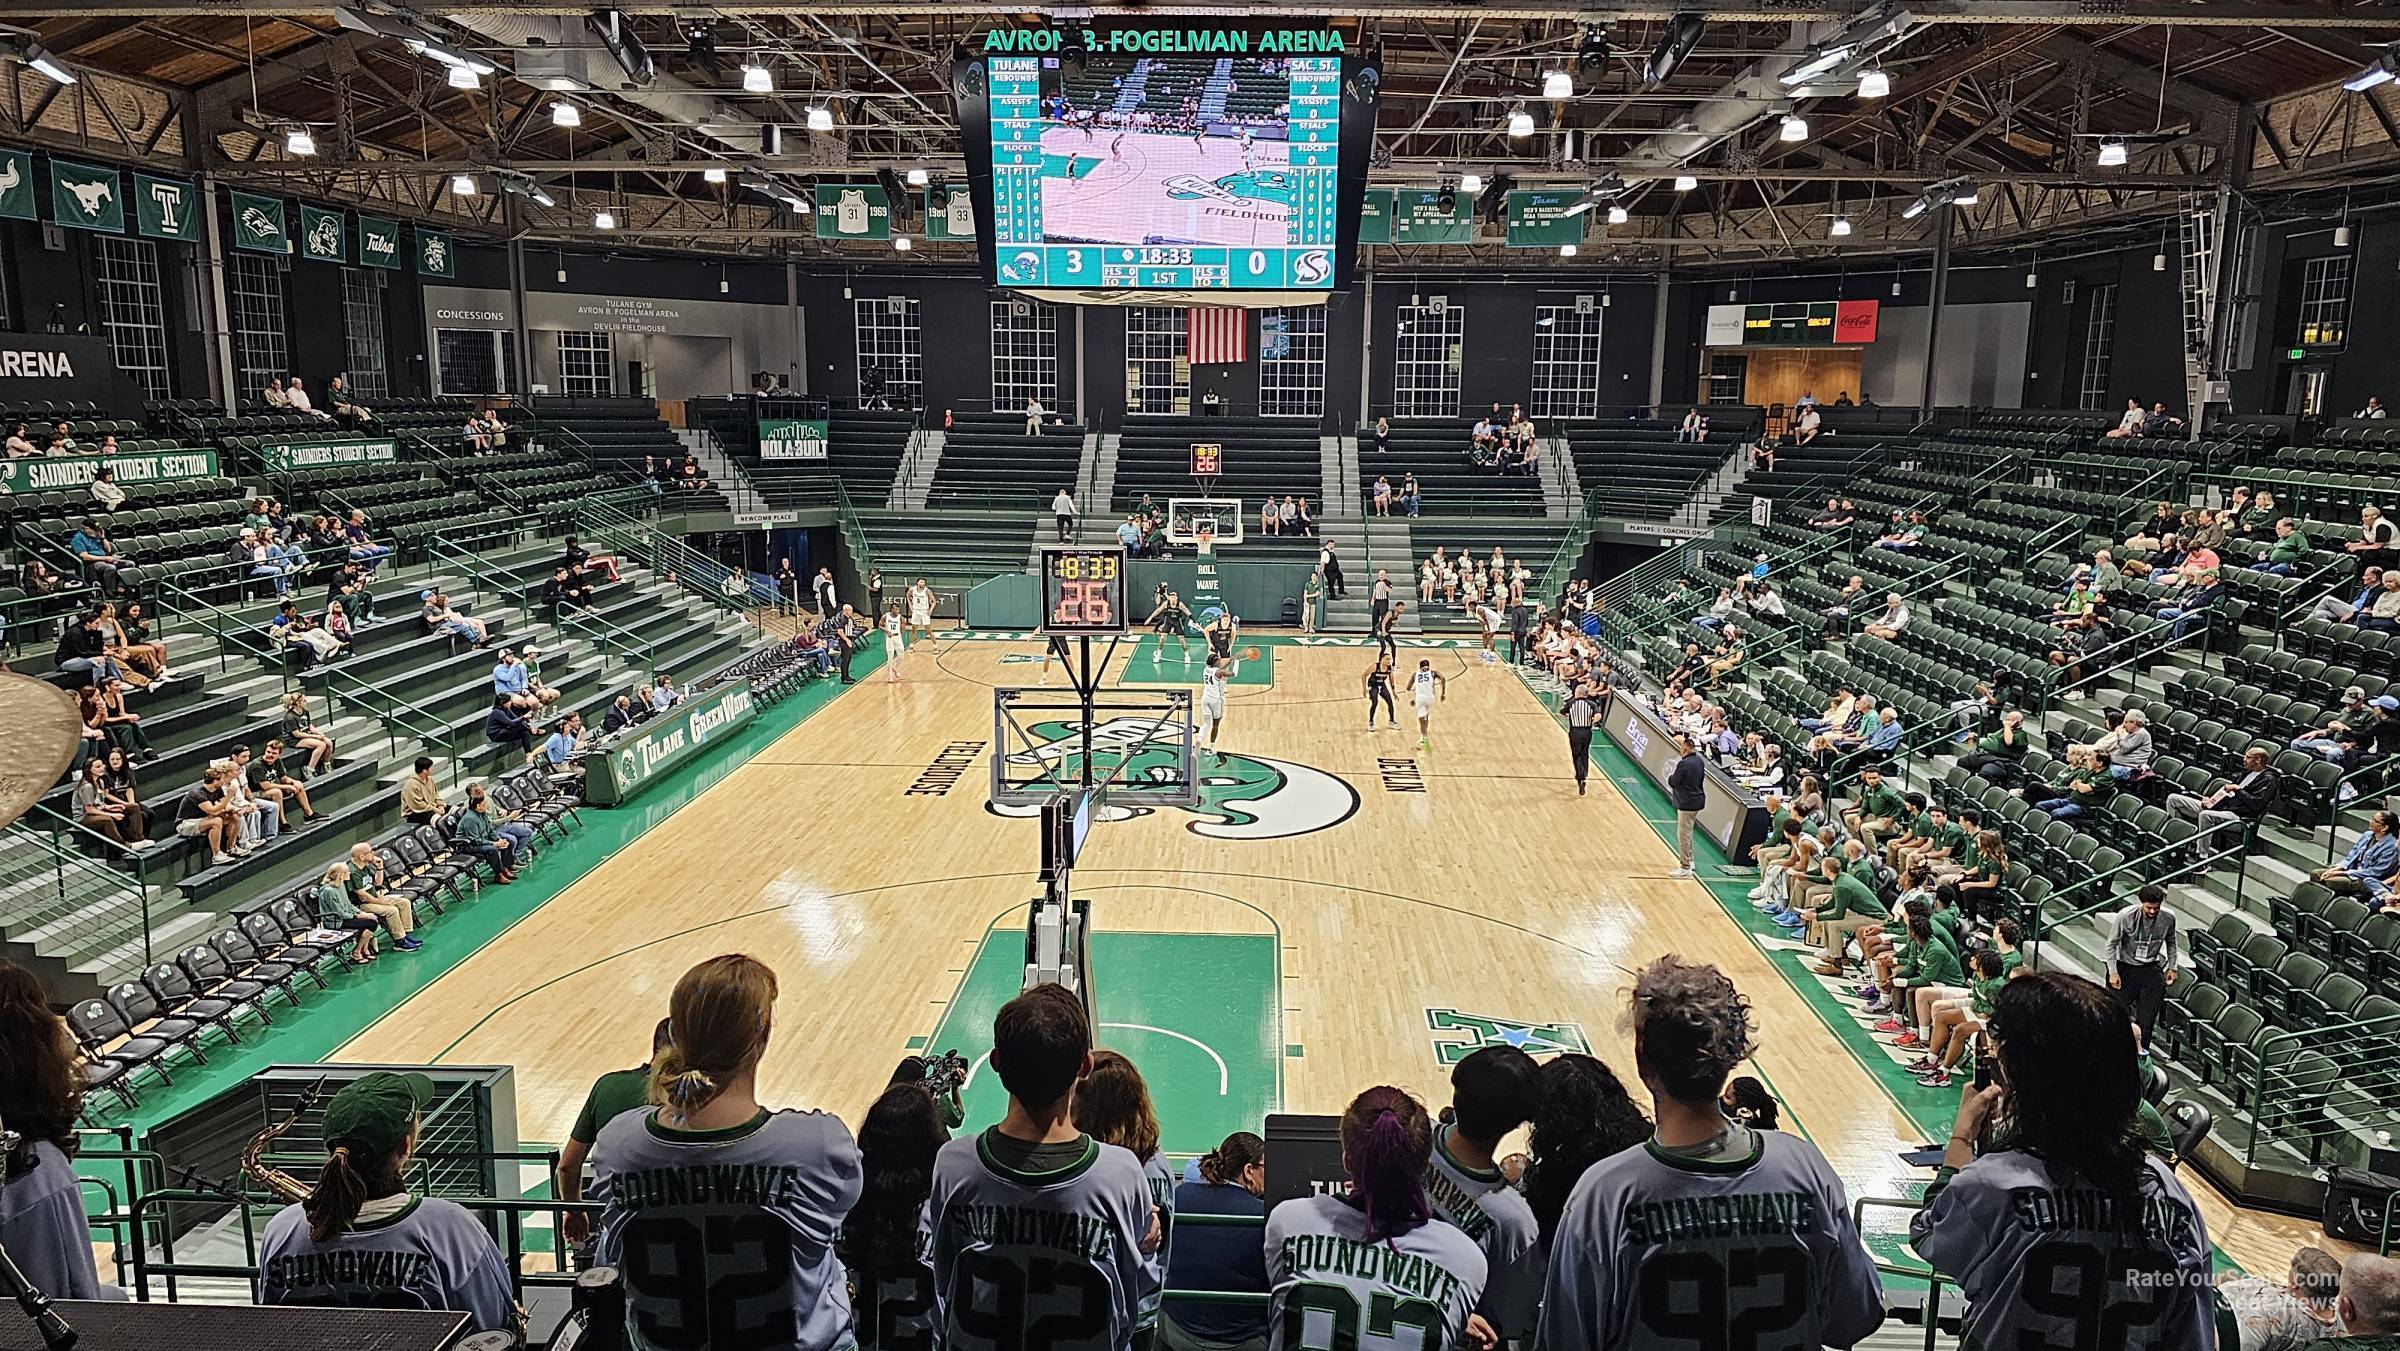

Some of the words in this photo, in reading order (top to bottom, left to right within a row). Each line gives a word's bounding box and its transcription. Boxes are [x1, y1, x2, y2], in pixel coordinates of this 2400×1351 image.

[1111, 30, 1247, 51] FOGELMAN
[1258, 30, 1345, 51] ARENA
[993, 60, 1037, 71] TULANE
[1319, 60, 1337, 71] ST.
[1012, 84, 1020, 94] 2
[1310, 85, 1318, 95] 2
[1013, 108, 1020, 117] 1
[1309, 109, 1317, 118] 0
[1013, 131, 1022, 140] 0
[1309, 132, 1317, 142] 0
[1003, 144, 1033, 152] BLOCKS
[1014, 154, 1022, 163] 0
[1308, 156, 1316, 165] 0
[998, 179, 1004, 187] 1
[1016, 179, 1022, 187] 0
[1033, 179, 1039, 187] 0
[1291, 180, 1297, 188] 1
[1308, 180, 1315, 188] 0
[1326, 180, 1332, 188] 0
[998, 192, 1005, 200] 5
[1016, 192, 1022, 200] 0
[1033, 192, 1039, 200] 0
[1289, 193, 1296, 202] 4
[1308, 193, 1314, 202] 0
[1326, 193, 1332, 202] 0
[1531, 195, 1560, 205] TULANE
[818, 205, 837, 216] 1967
[848, 209, 858, 220] 31
[869, 206, 887, 217] 1969
[996, 205, 1007, 213] 12
[1017, 205, 1023, 213] 3
[1034, 205, 1039, 213] 0
[1287, 207, 1298, 215] 15
[1308, 207, 1314, 215] 0
[1325, 207, 1332, 215] 0
[956, 210, 968, 222] 33
[997, 219, 1008, 227] 24
[1017, 219, 1023, 227] 0
[1034, 219, 1040, 227] 0
[1287, 221, 1298, 229] 24
[1308, 221, 1313, 229] 0
[1325, 221, 1331, 229] 0
[998, 232, 1008, 240] 25
[1018, 232, 1023, 240] 0
[1034, 232, 1040, 240] 0
[1287, 234, 1297, 242] 31
[1307, 234, 1313, 242] 0
[1325, 234, 1331, 242] 0
[366, 232, 395, 254] Tulsa
[1066, 250, 1083, 273] 3
[1139, 249, 1193, 265] 18:33
[1248, 251, 1267, 275] 0
[1104, 267, 1122, 276] FLS
[1128, 267, 1136, 276] 0
[1196, 268, 1213, 277] FLS
[1220, 268, 1227, 277] 0
[1104, 278, 1119, 287] TO
[1127, 278, 1136, 287] 4
[1152, 272, 1178, 285] 1ST
[1196, 279, 1211, 287] TO
[1219, 279, 1227, 287] 4
[606, 299, 635, 308] TULANE
[636, 300, 652, 309] GYM
[893, 302, 901, 313] N
[1434, 302, 1443, 314] Q
[1581, 302, 1589, 312] R
[437, 309, 504, 321] CONCESSIONS
[578, 306, 604, 315] AVRON
[605, 307, 613, 315] B.
[614, 308, 654, 317] FOGELMAN
[655, 310, 680, 318] ARENA
[594, 322, 621, 331] DEVLIN
[622, 323, 667, 333] FIELDHOUSE
[0, 350, 75, 378] RENA
[761, 439, 794, 457] NOLA
[794, 439, 828, 457] BUILT
[1196, 447, 1218, 456] 18:33
[291, 446, 332, 466] SAUNDERS
[333, 445, 366, 463] STUDENT
[366, 444, 393, 460] SECTION
[1196, 456, 1216, 472] 26
[29, 460, 99, 489] SAUNDERS
[161, 454, 208, 478] SECTION
[1060, 557, 1117, 580] 18:33
[1197, 565, 1217, 575] ROLL
[1196, 580, 1219, 590] WAVE
[1061, 581, 1109, 622] 26
[1204, 675, 1214, 685] 24
[1417, 673, 1430, 683] 25
[1626, 716, 1649, 747] Bryan
[637, 727, 685, 778] TULANE
[904, 741, 987, 796] FIELDHOUSE
[1377, 758, 1427, 793] DEVLIN
[611, 1164, 798, 1210] SOUNDWAVE
[1627, 1191, 1815, 1245] SOUNDWAVE
[950, 1203, 1114, 1263] SOUNDWAVE
[269, 1250, 433, 1291] SOUNDWAVE
[1282, 1233, 1460, 1315] SOUNDWAVE
[622, 1215, 798, 1351] 92
[951, 1253, 1113, 1351] 92
[1639, 1247, 1812, 1351] 92
